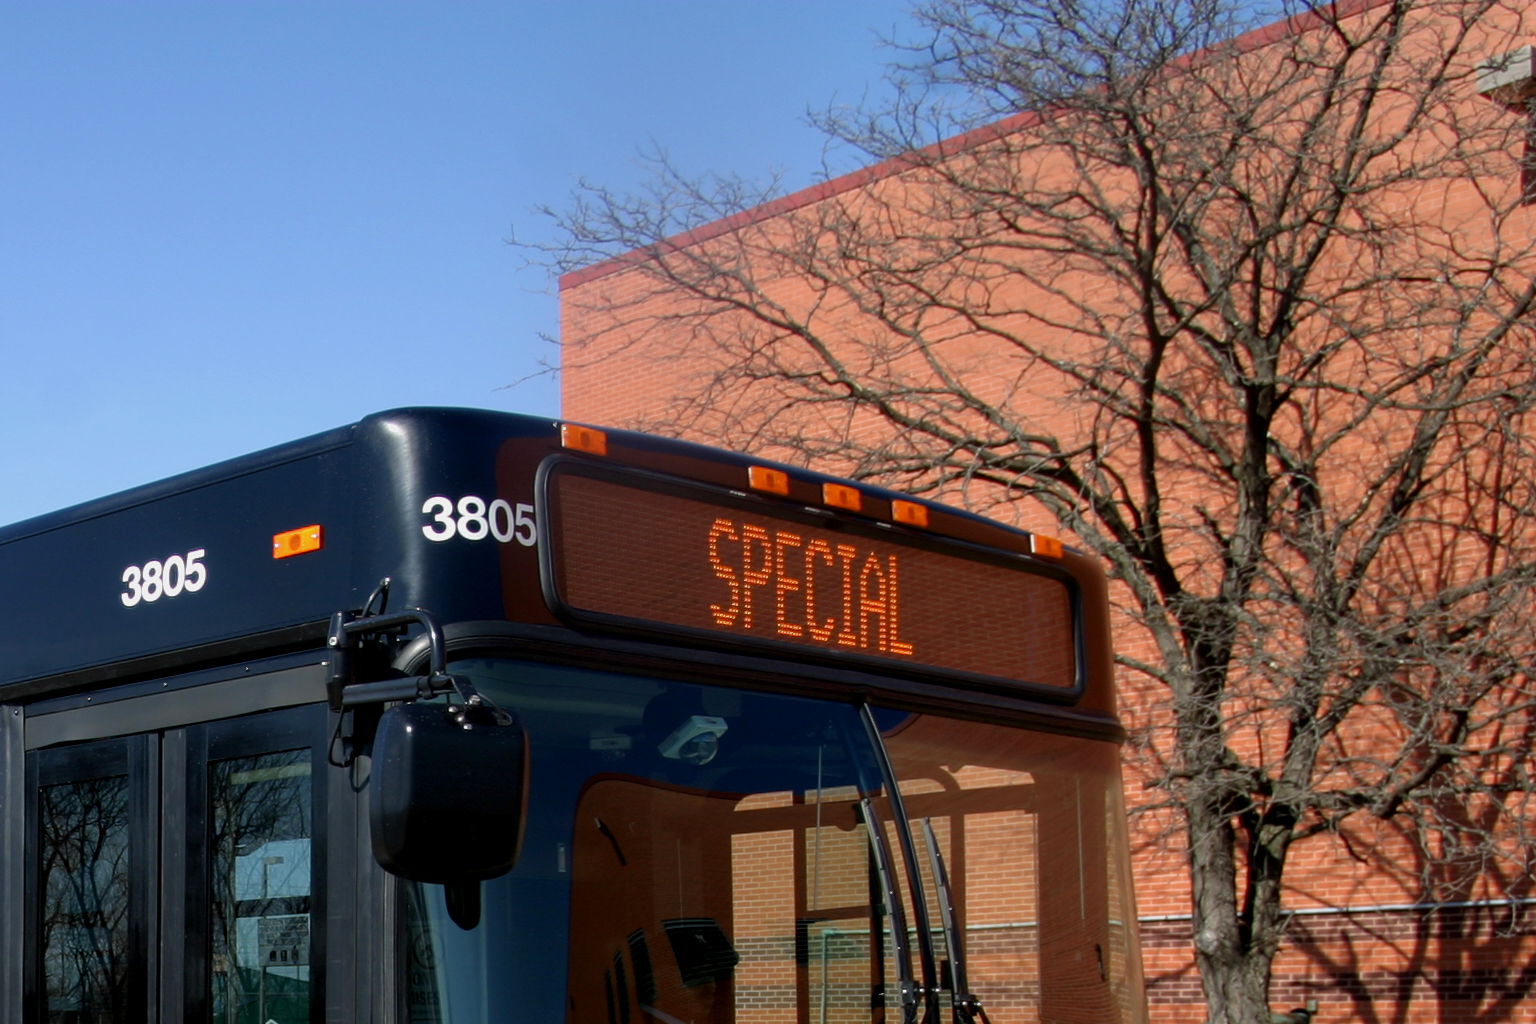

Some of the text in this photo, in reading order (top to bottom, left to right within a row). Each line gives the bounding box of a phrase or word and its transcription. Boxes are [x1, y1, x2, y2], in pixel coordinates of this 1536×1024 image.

[421, 495, 538, 547] 3805
[120, 548, 207, 608] 3805
[709, 517, 915, 656] SPECIAL
